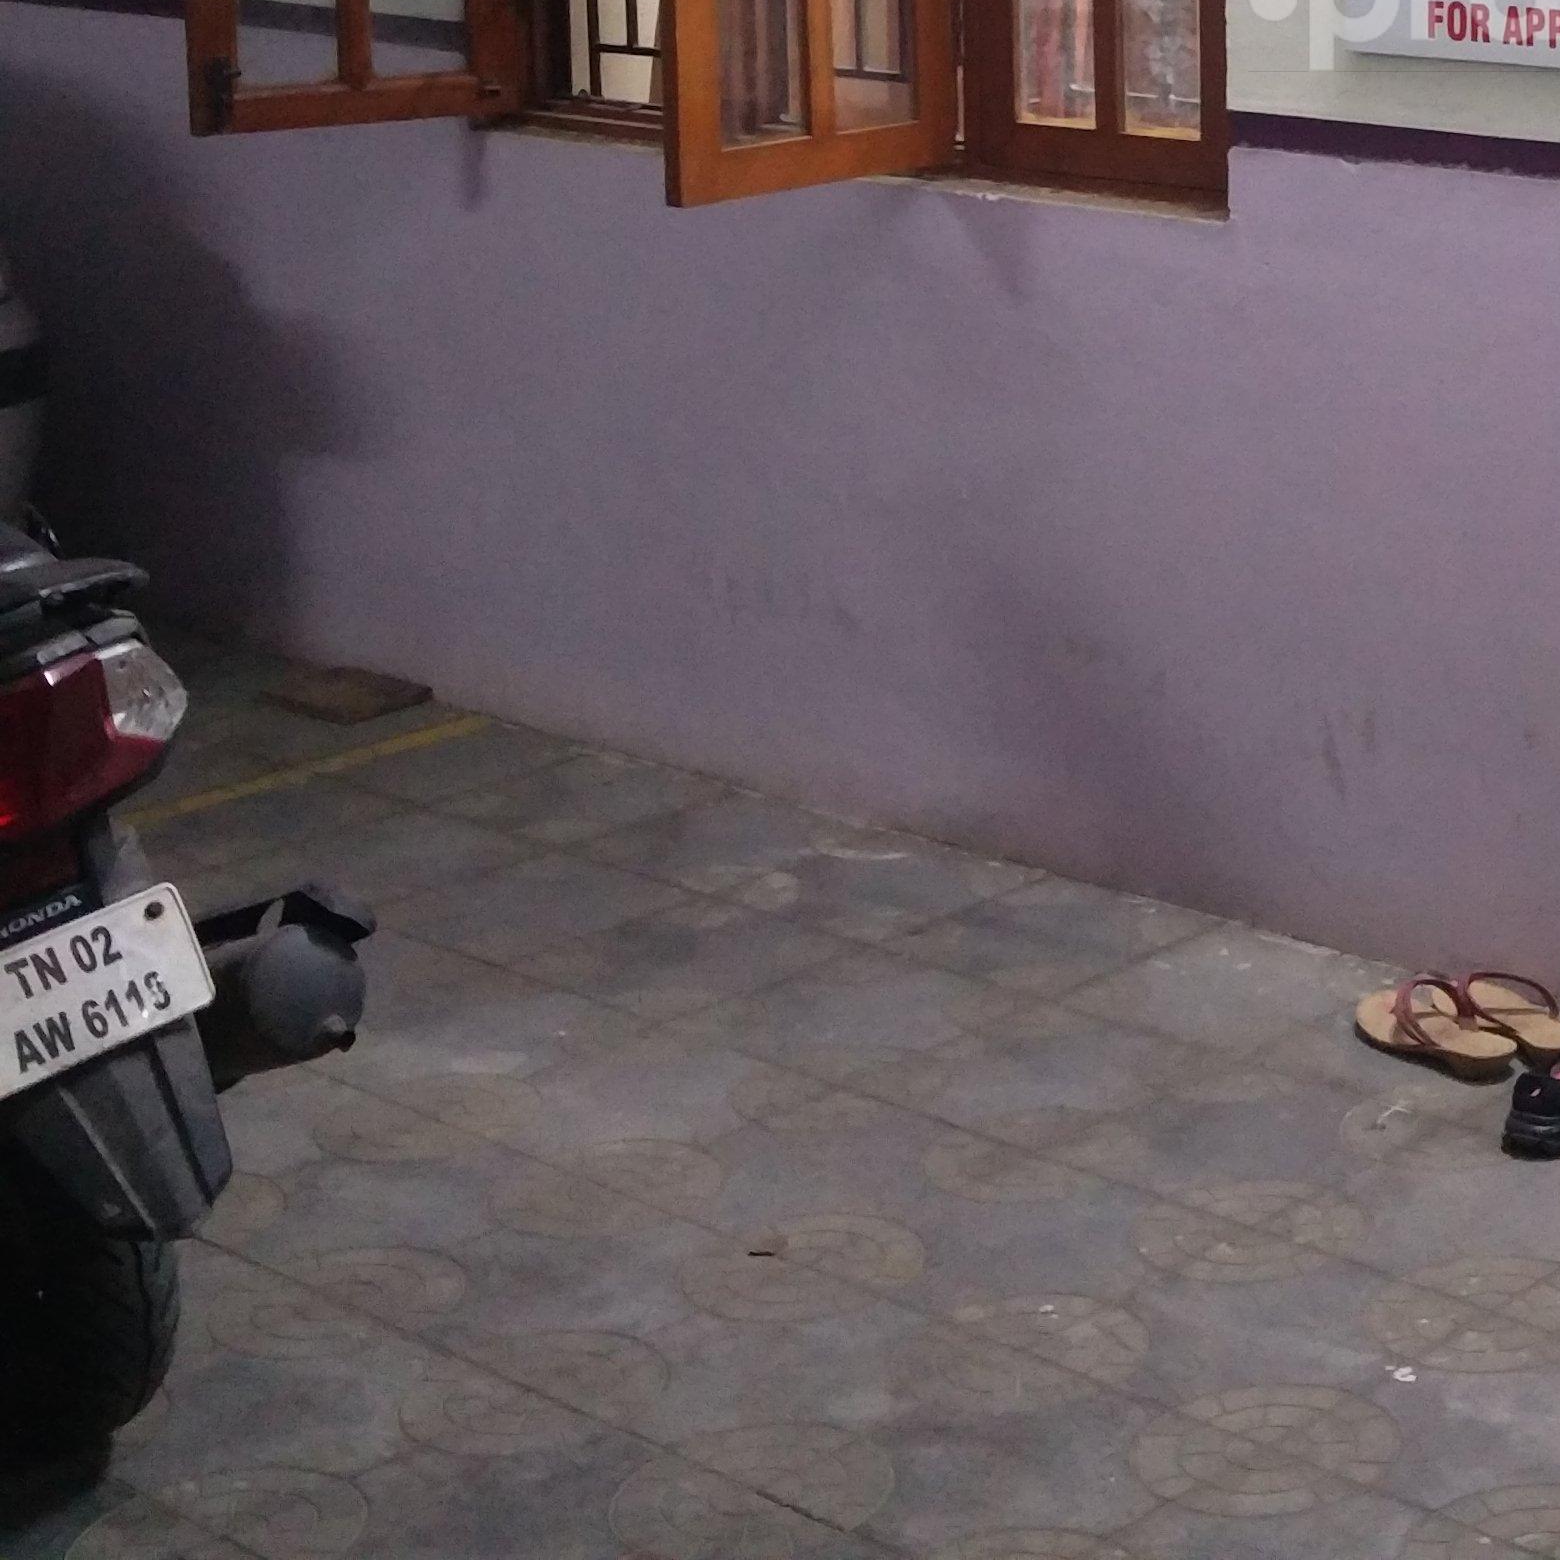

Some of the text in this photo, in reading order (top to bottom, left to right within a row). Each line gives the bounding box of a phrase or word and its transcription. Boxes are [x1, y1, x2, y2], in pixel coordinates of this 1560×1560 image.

[1428, 0, 1491, 43] FOR
[4, 926, 123, 999] TN 02
[14, 1011, 75, 1074] AW
